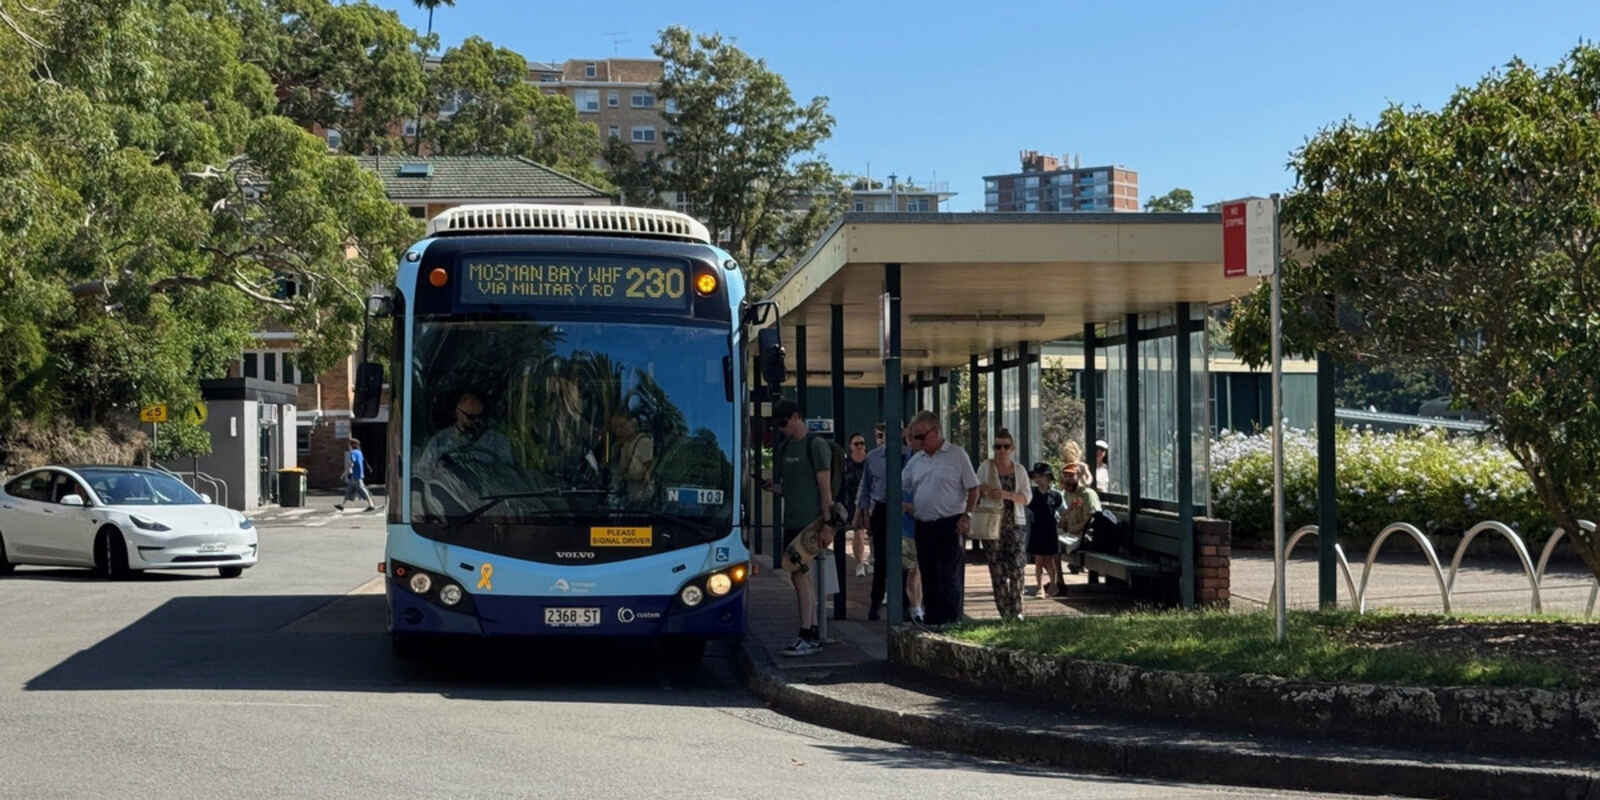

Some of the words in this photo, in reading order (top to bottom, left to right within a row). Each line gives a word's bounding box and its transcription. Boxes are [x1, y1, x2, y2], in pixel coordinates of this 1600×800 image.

[468, 263, 543, 281] MOSMAN
[547, 265, 583, 283] BAY
[588, 266, 623, 284] WHF
[478, 282, 508, 295] VIA
[511, 283, 587, 296] MILITARY
[592, 284, 614, 297] RD
[625, 267, 684, 298] 230
[700, 490, 722, 504] 103
[607, 528, 637, 536] PLEASE
[592, 537, 620, 545] SIGNAL
[622, 537, 650, 545] DRIVER
[555, 551, 595, 559] VOLVO
